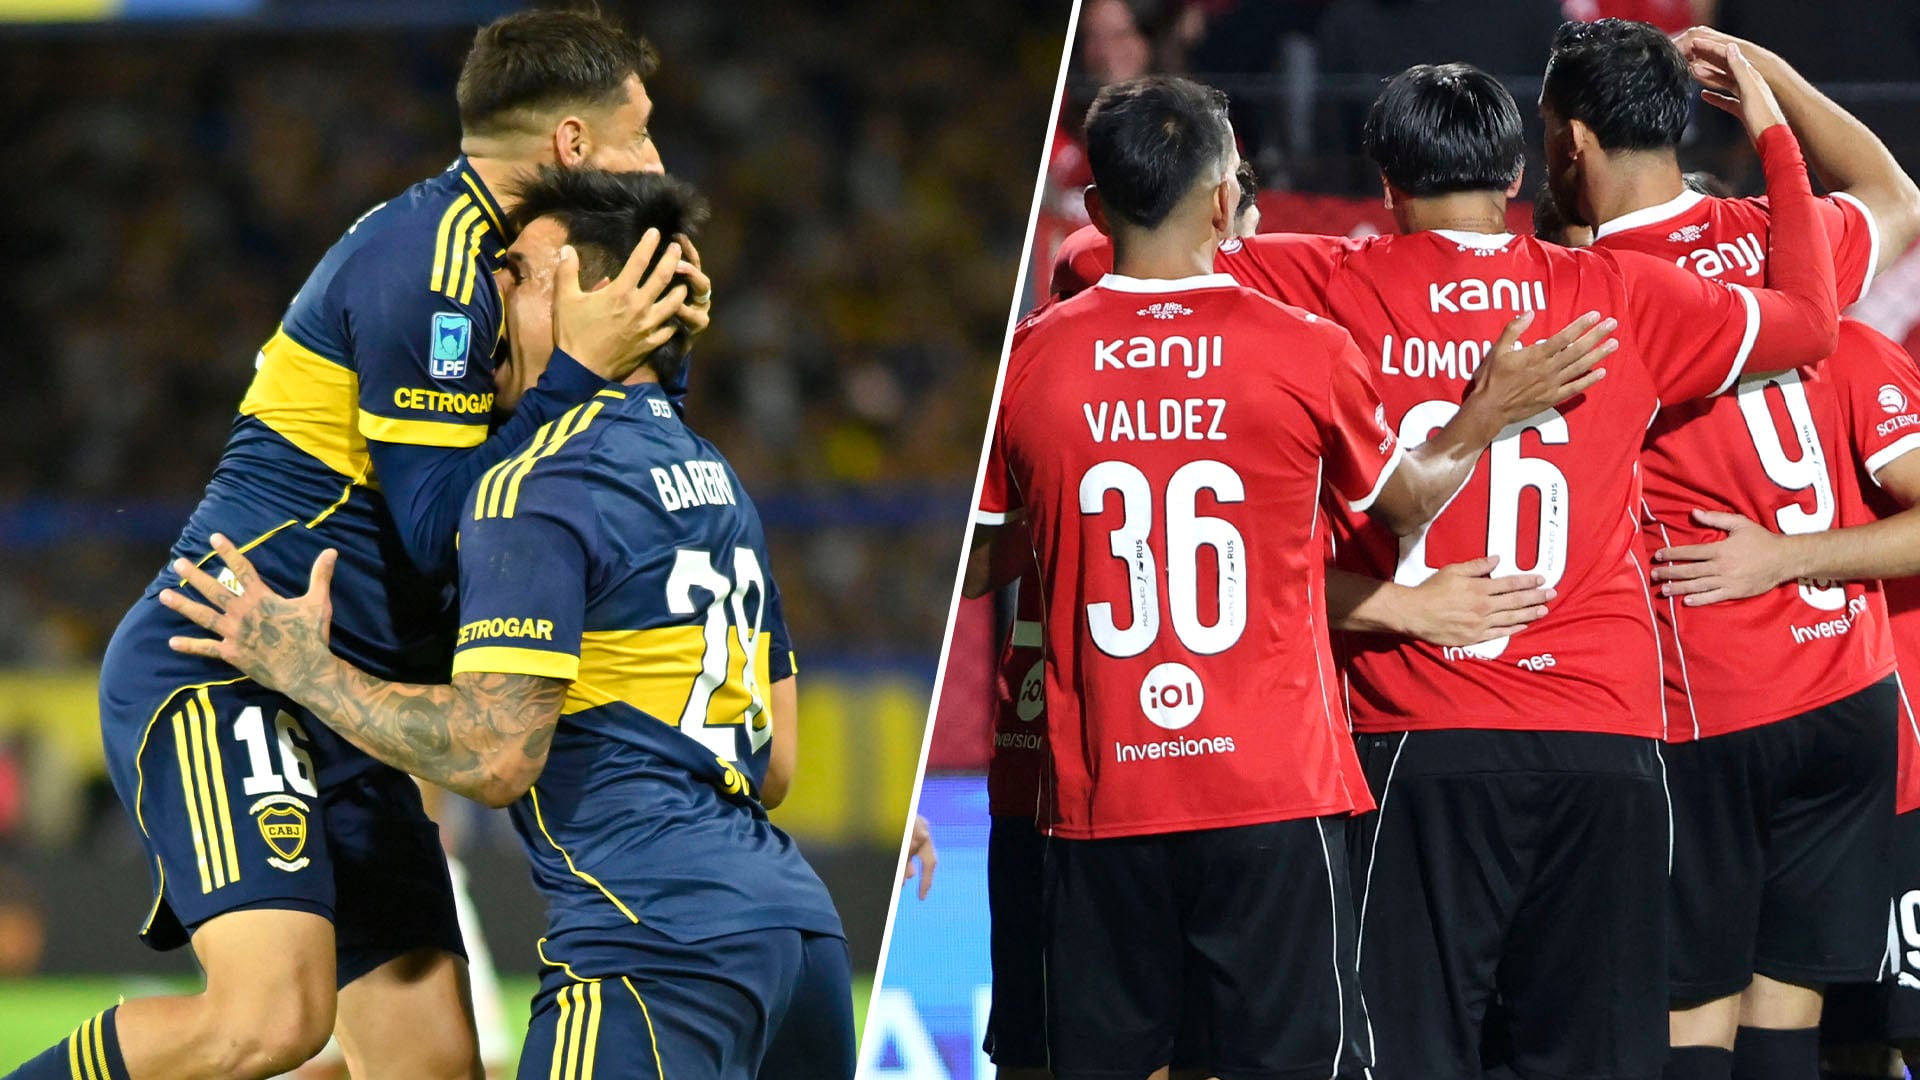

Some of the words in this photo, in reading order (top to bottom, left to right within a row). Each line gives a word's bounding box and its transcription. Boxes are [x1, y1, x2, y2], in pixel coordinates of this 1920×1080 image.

[1675, 233, 1765, 277] anji
[432, 360, 465, 376] LPF
[1083, 398, 1228, 444] VALDEZ
[1737, 369, 1836, 536] 9
[1078, 459, 1247, 659] 36
[1136, 539, 1144, 559] RUS
[1226, 540, 1234, 559] RUS
[233, 706, 318, 798] 16
[1115, 734, 1236, 763] Inversiones
[268, 826, 300, 836] CABJ
